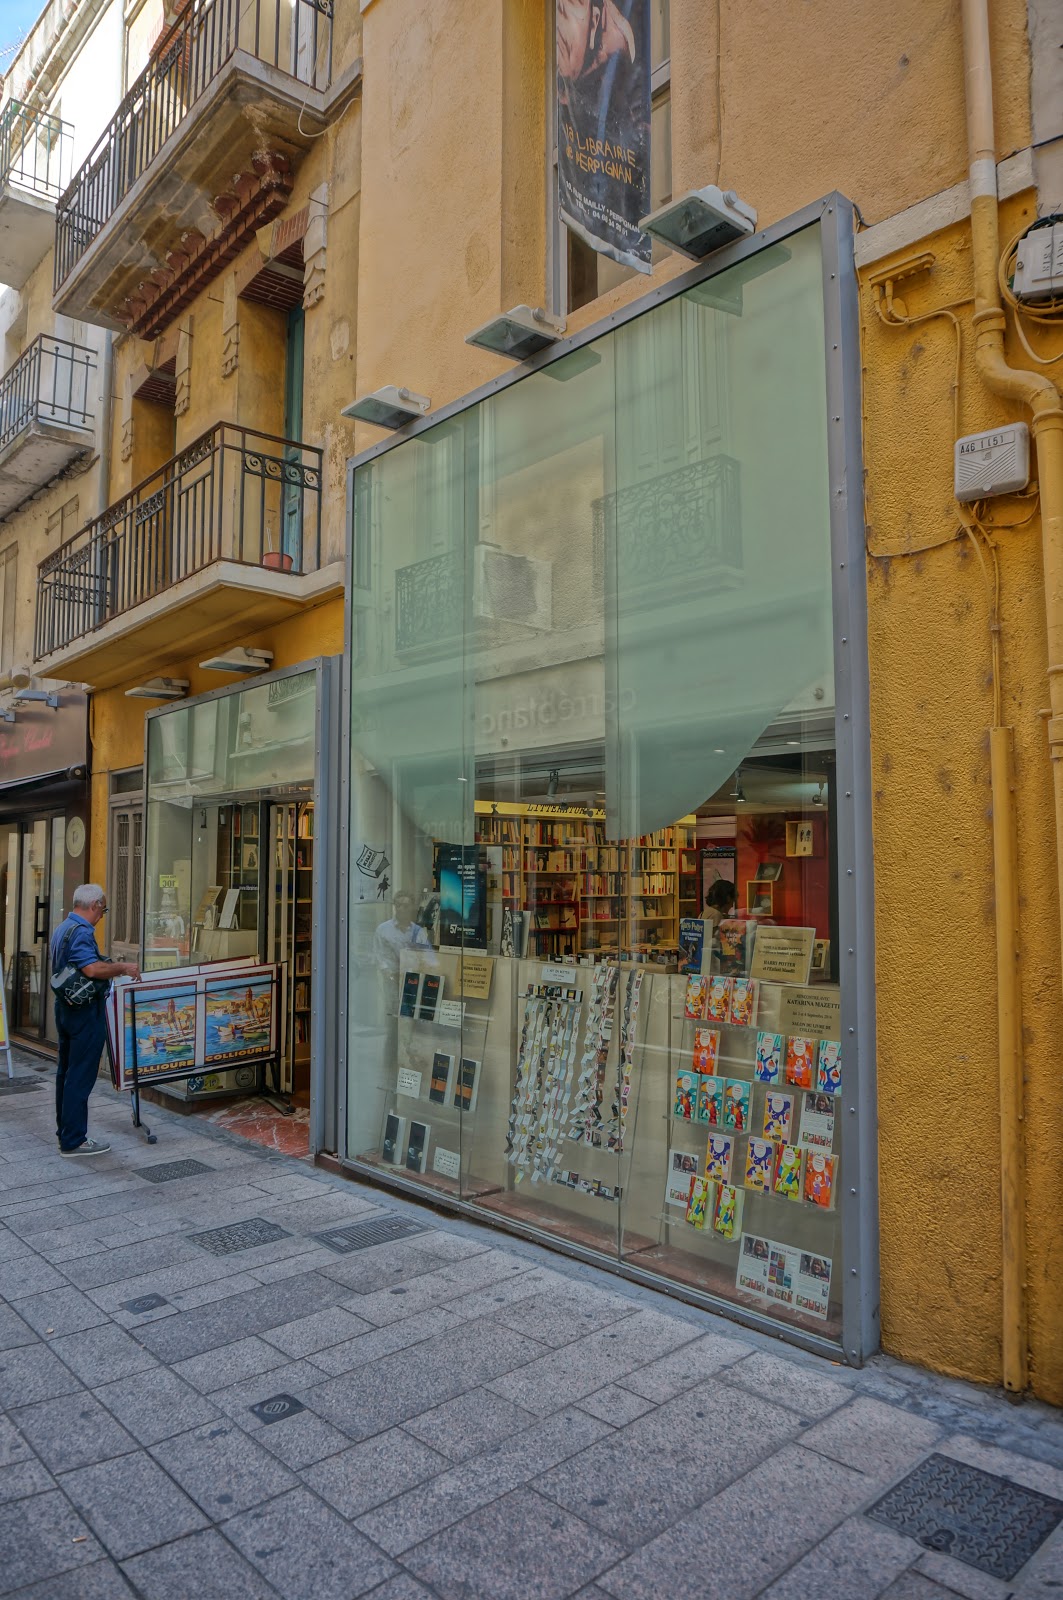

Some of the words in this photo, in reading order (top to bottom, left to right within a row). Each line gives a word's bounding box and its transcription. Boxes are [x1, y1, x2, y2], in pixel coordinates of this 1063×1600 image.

[576, 131, 637, 168] LIBRAIRIE
[583, 196, 605, 212] MAILLY
[610, 209, 641, 233] PERPIGNAN
[960, 442, 976, 454] A46
[786, 998, 815, 1007] KATARINA
[815, 1001, 840, 1009] MAZETTI
[205, 1046, 270, 1062] COLLIOURE
[125, 1060, 195, 1076] COLLIOURE
